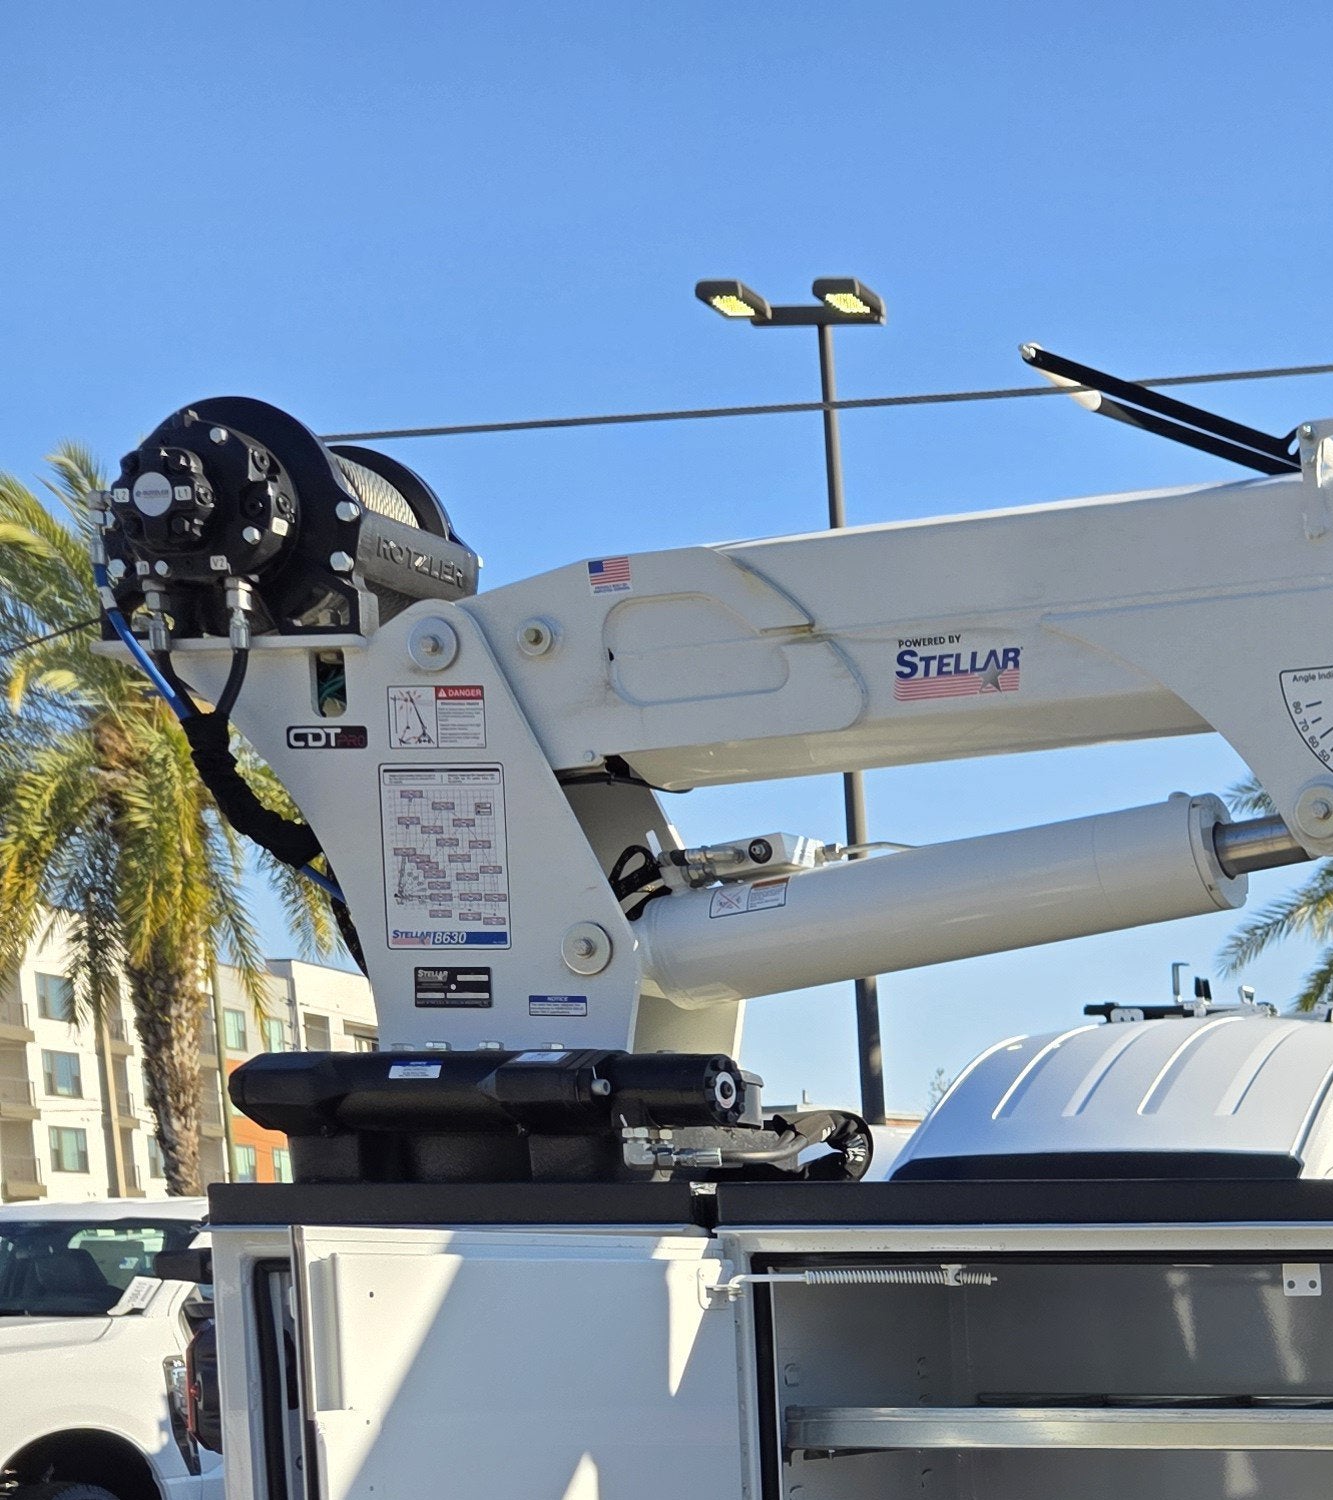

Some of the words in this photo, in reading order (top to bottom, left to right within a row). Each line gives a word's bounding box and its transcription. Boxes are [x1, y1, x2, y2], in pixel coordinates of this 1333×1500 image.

[115, 491, 128, 500] L2
[177, 488, 189, 499] L1
[211, 557, 225, 569] V2
[377, 535, 465, 589] ROTZLER
[898, 636, 946, 649] POWERED
[948, 634, 962, 644] BY
[895, 647, 1021, 680] STELLAR
[1292, 673, 1317, 684] Angle
[448, 688, 482, 698] DANGER
[1292, 701, 1303, 715] 80
[1298, 718, 1310, 733] 70
[289, 727, 342, 747] CDT
[1308, 735, 1320, 749] 60
[1318, 750, 1331, 762] 50
[392, 929, 431, 939] STELLAR
[434, 931, 467, 944] 8630
[417, 969, 449, 978] STELLAR
